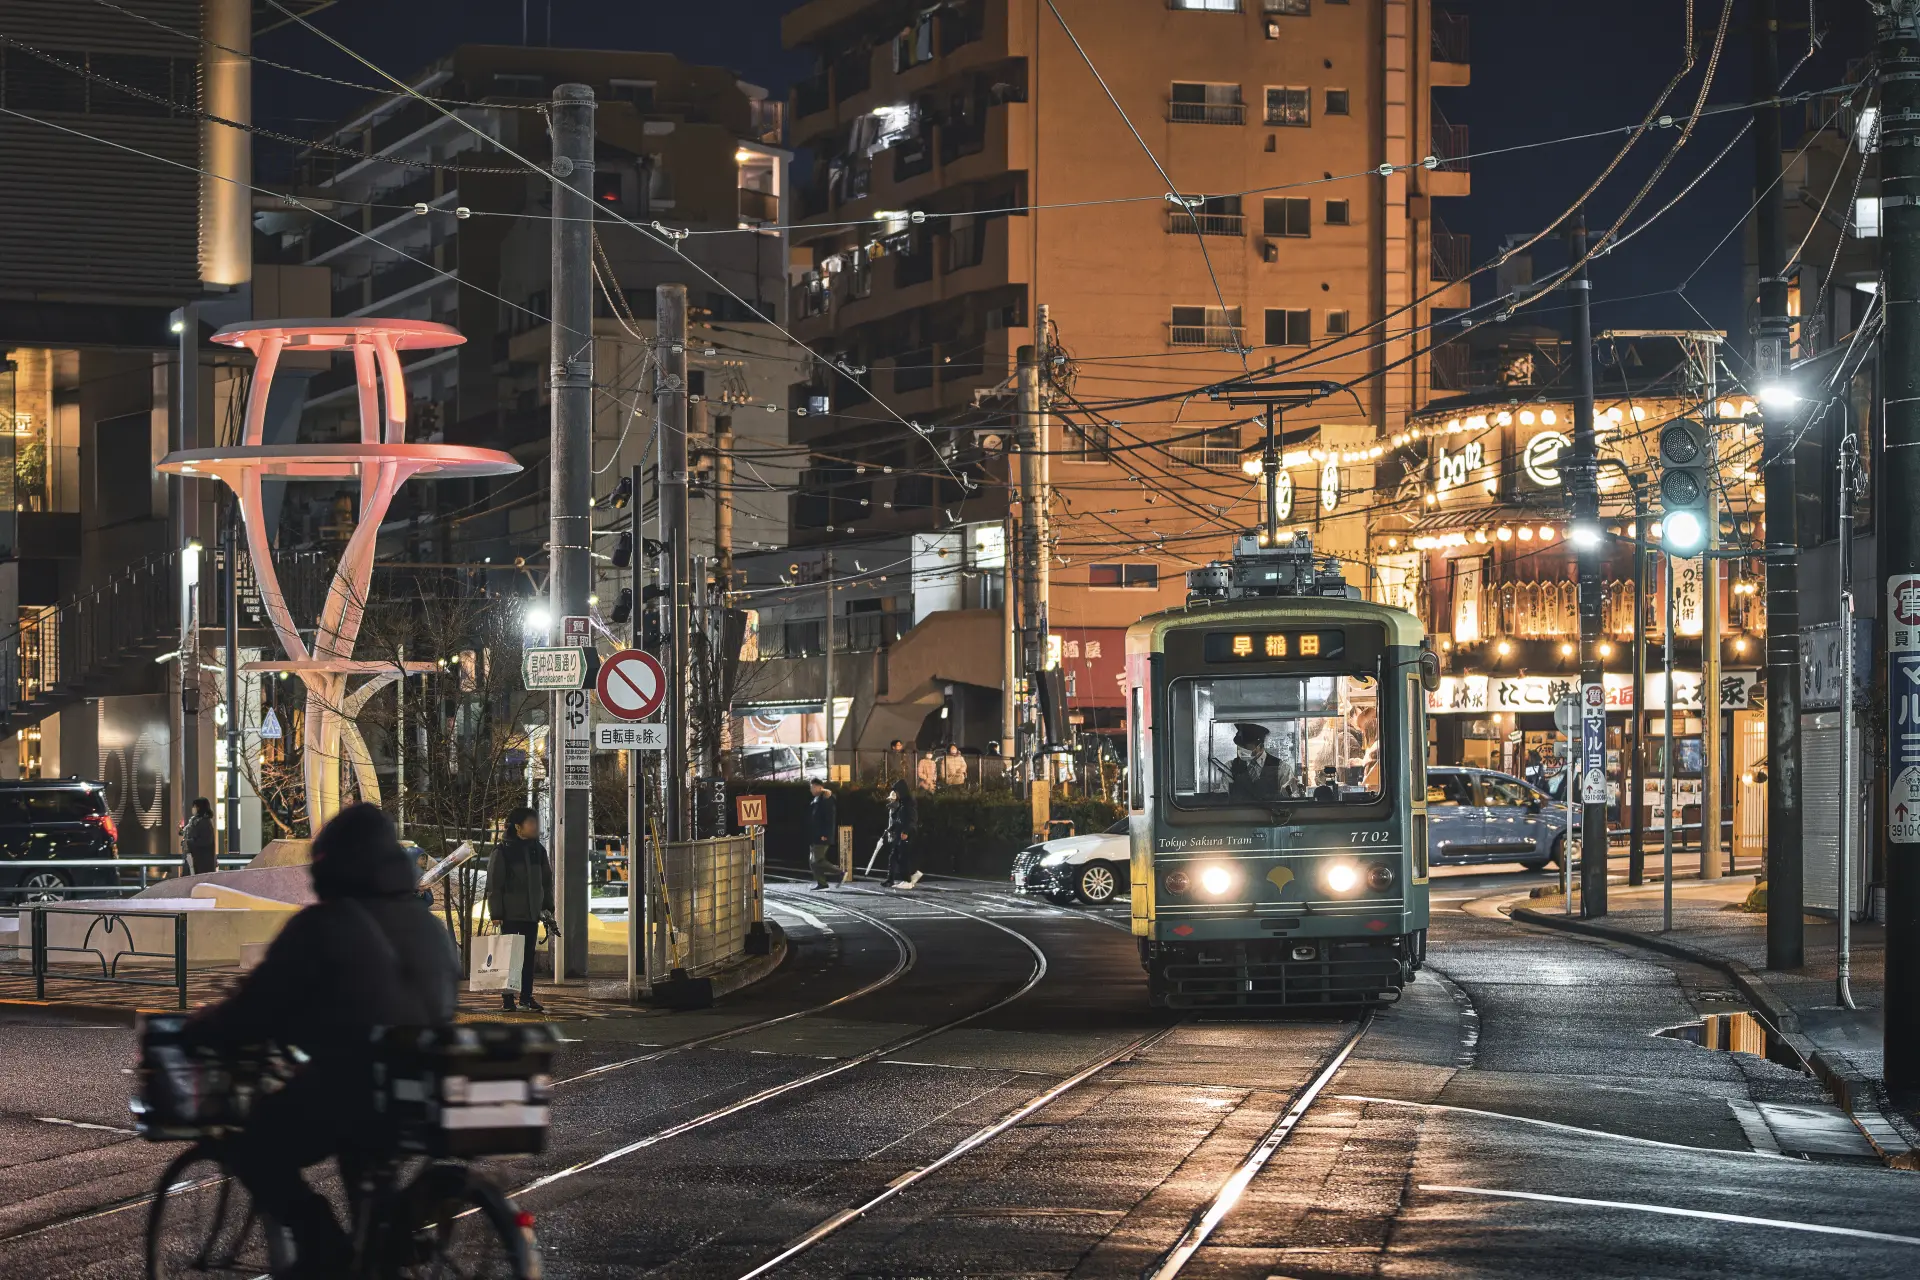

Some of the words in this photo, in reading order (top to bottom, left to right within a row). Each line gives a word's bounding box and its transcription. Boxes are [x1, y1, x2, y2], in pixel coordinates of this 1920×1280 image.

[1682, 568, 1696, 620] のれん街
[1232, 635, 1320, 657] 早稲田
[1588, 689, 1601, 704] 質
[600, 728, 661, 744] 自転車を除く
[1587, 719, 1603, 768] マルヨ
[742, 803, 761, 818] W
[1158, 837, 1187, 851] Tokyo
[1189, 836, 1224, 847] Sakura
[1226, 836, 1252, 845] Tram
[1350, 831, 1389, 842] 7702
